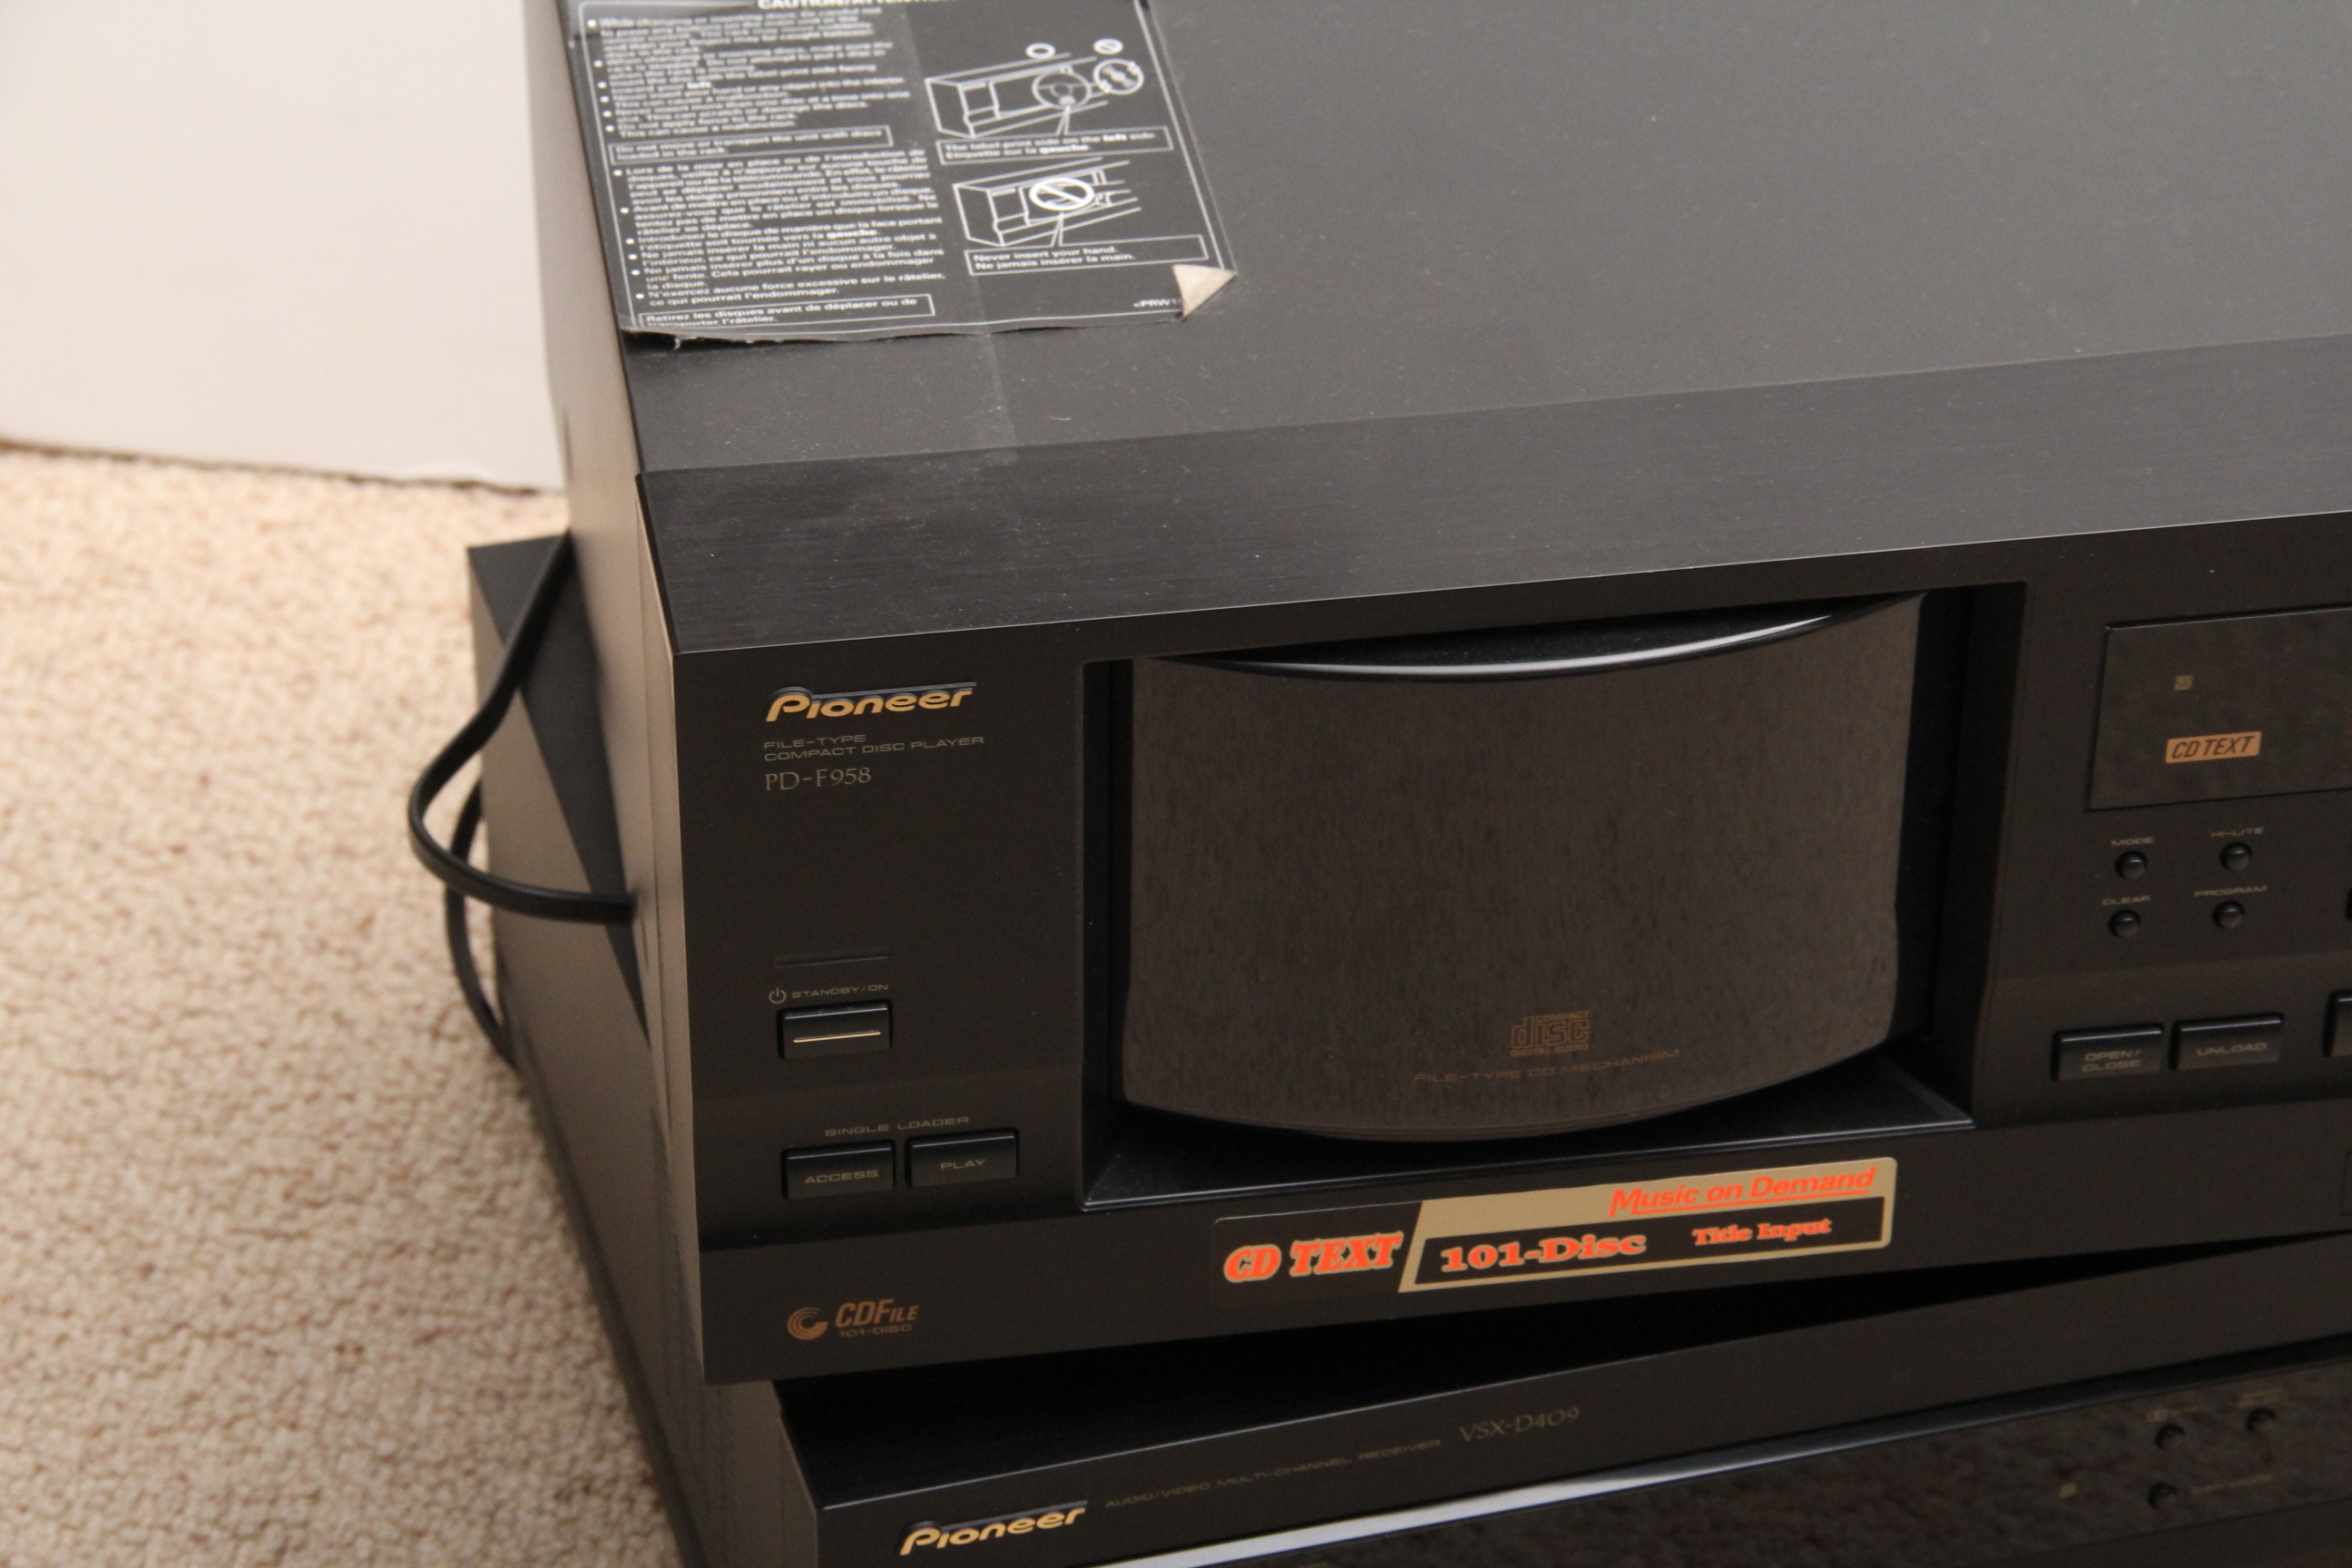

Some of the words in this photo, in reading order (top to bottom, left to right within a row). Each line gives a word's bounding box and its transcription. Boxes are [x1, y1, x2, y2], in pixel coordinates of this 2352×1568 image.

[996, 260, 1038, 270] jamais
[1040, 257, 1083, 265] insérer
[1100, 253, 1134, 261] main.
[1013, 250, 1049, 259] insert
[1053, 250, 1080, 258] your
[1082, 246, 1118, 254] hand.
[646, 314, 690, 322] Retirez
[715, 309, 764, 318] disques
[768, 305, 802, 314] avant
[824, 301, 877, 310] déplacer
[765, 683, 976, 722] Pioneer
[764, 734, 866, 750] FILE-TYPE
[764, 747, 857, 761] COMPACT
[862, 742, 906, 754] DISC
[911, 737, 985, 750] PLAYER
[2171, 741, 2201, 760] CD
[2203, 735, 2255, 757] TEXT
[765, 767, 871, 791] PD-F958
[2111, 837, 2154, 847] MODE
[2102, 895, 2151, 906] CLEAR
[2194, 885, 2268, 897] PROGRAM
[2196, 1043, 2267, 1056] UNLOAD
[2082, 1060, 2141, 1073] CLOSE
[825, 1123, 890, 1136] SINGLE
[897, 1116, 969, 1130] LOADER
[940, 1159, 985, 1170] PLAY
[805, 1170, 878, 1183] ACCESS
[1610, 1184, 1698, 1216] Music
[1706, 1184, 1742, 1202] on
[1749, 1166, 1877, 1198] Demand
[1441, 1234, 1647, 1272] 101-Disc
[1691, 1225, 1752, 1246] Title
[1757, 1218, 1832, 1241] Input
[1224, 1244, 1281, 1282] CD
[1289, 1231, 1404, 1277] TEXT
[1460, 1407, 1581, 1442] VSX-D409
[899, 1501, 1088, 1555] Pioneer
